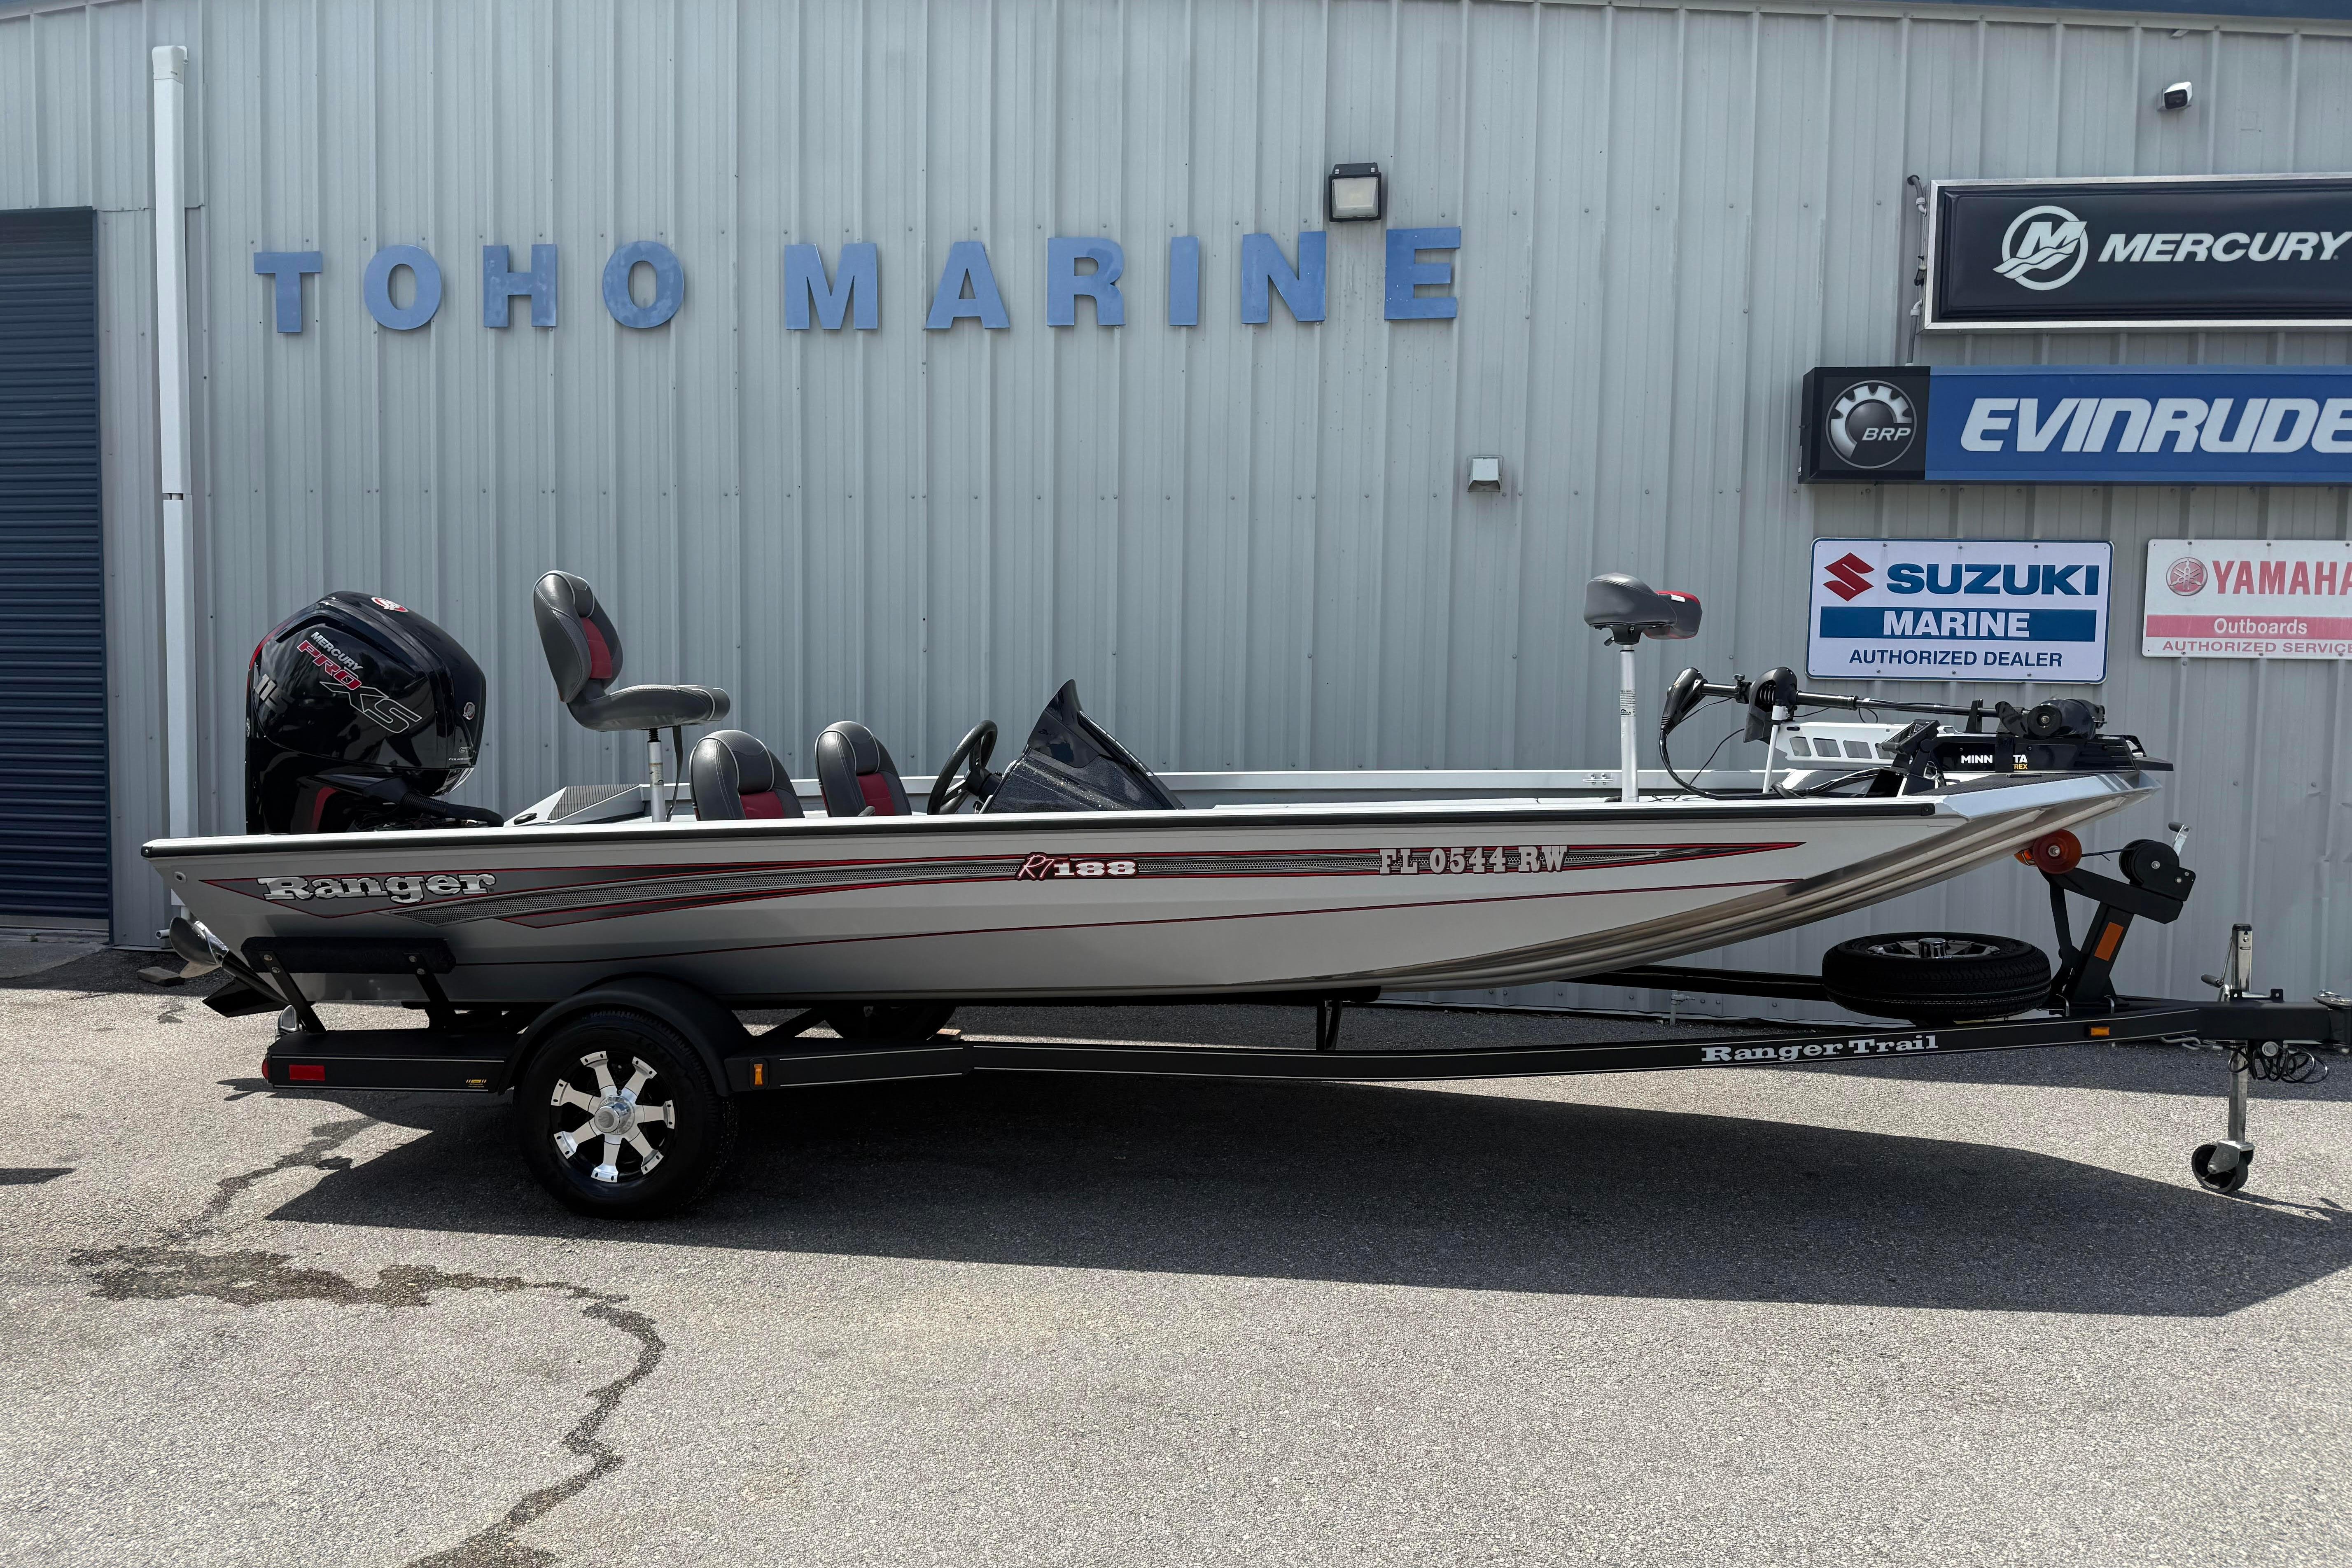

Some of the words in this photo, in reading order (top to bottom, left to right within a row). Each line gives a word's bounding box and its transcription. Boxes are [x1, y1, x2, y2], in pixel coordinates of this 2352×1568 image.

[2098, 231, 2352, 262] MERCURY
[254, 241, 684, 333] TOHO
[785, 226, 1461, 330] MARINE
[1862, 427, 1911, 441] BRP
[1960, 398, 2352, 453] EVINRUDE
[1887, 563, 2099, 595] SUZUKI
[2212, 560, 2352, 595] YAMAHA
[1883, 610, 2030, 637] MARINE
[2214, 618, 2308, 634] Outboards
[310, 631, 363, 670] MERCURY
[1849, 649, 1977, 666] AUTHORIZED
[1984, 651, 2062, 667] DEALER
[2162, 641, 2277, 652] AUTHORIZED
[297, 640, 362, 690] PRO
[319, 667, 422, 733] XS
[1961, 755, 1993, 764] MINN
[2013, 754, 2028, 763] TA
[1379, 849, 1419, 875] FL
[1429, 847, 1507, 874] 0544
[1518, 845, 1567, 873] RW
[256, 873, 496, 904] Ranger
[1701, 1043, 1843, 1061] Ranger
[1848, 1035, 1939, 1054] Trail
